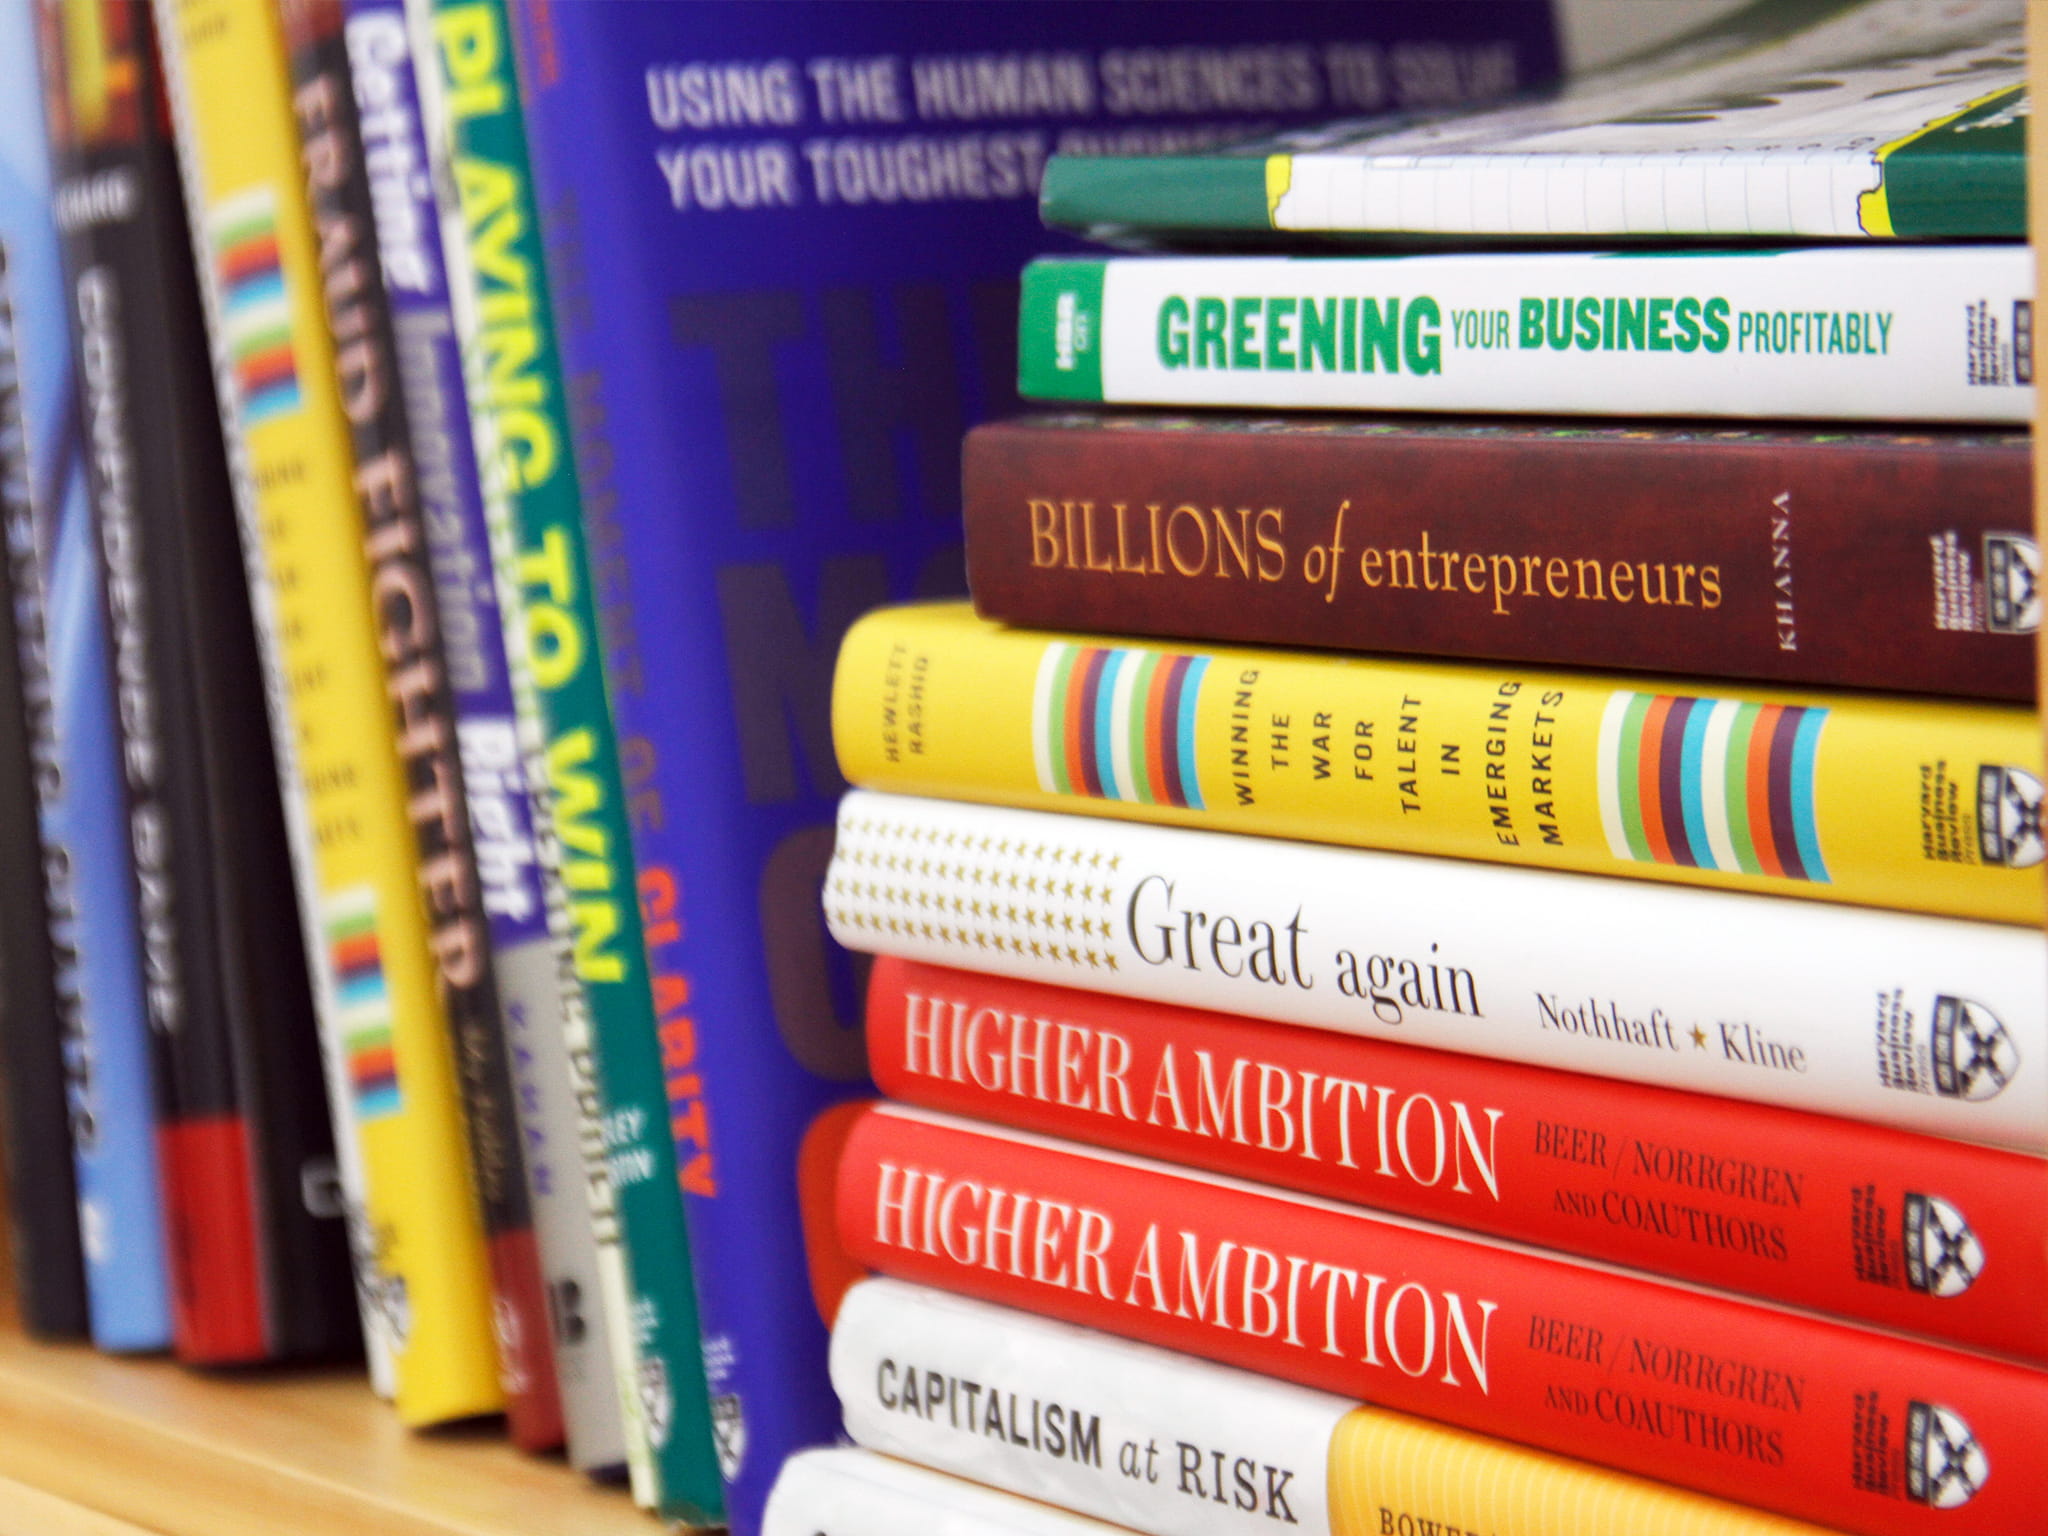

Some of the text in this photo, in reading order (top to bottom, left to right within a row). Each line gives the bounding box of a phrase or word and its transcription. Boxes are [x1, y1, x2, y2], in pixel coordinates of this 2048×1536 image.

[645, 64, 799, 130] USING
[807, 57, 904, 124] THE
[912, 50, 1096, 120] HUMAN
[655, 140, 799, 211] YOUR
[804, 129, 1044, 203] TOUGHEST
[432, 6, 558, 490] PLAYING
[1156, 295, 1894, 377] GREENING YOUR BUSINESS PROFITABLY
[520, 525, 582, 690] TO
[1026, 498, 1724, 616] BILLIONS of entrepreneurs
[1770, 491, 1799, 654] KHANNA
[1230, 669, 1259, 808] WINNING
[1271, 713, 1291, 772] THE
[1312, 711, 1333, 781] WAR
[1354, 720, 1375, 782] FOR
[1395, 694, 1424, 815] TALENT
[1441, 742, 1461, 777] IN
[1485, 681, 1523, 849] EMERGING
[1531, 689, 1565, 848] MARKETS
[546, 728, 625, 985] WIN
[1126, 874, 1487, 1026] Great again
[636, 866, 717, 1200] CLARITY
[1535, 992, 1808, 1075] Nothhaft Kline
[903, 993, 1504, 1202] HIGHER AMBITION
[1533, 1120, 1609, 1170] BEER
[1632, 1139, 1806, 1210] NORRGREN
[873, 1162, 1499, 1398] HIGHER AMBITION
[1552, 1188, 1790, 1263] AND COAUTHORS
[1528, 1314, 1604, 1367] BEER
[1628, 1337, 1806, 1415] NORRGREN
[876, 1358, 1300, 1526] CAPITALISM at RISK
[1544, 1384, 1786, 1468] AND COAUTHORS
